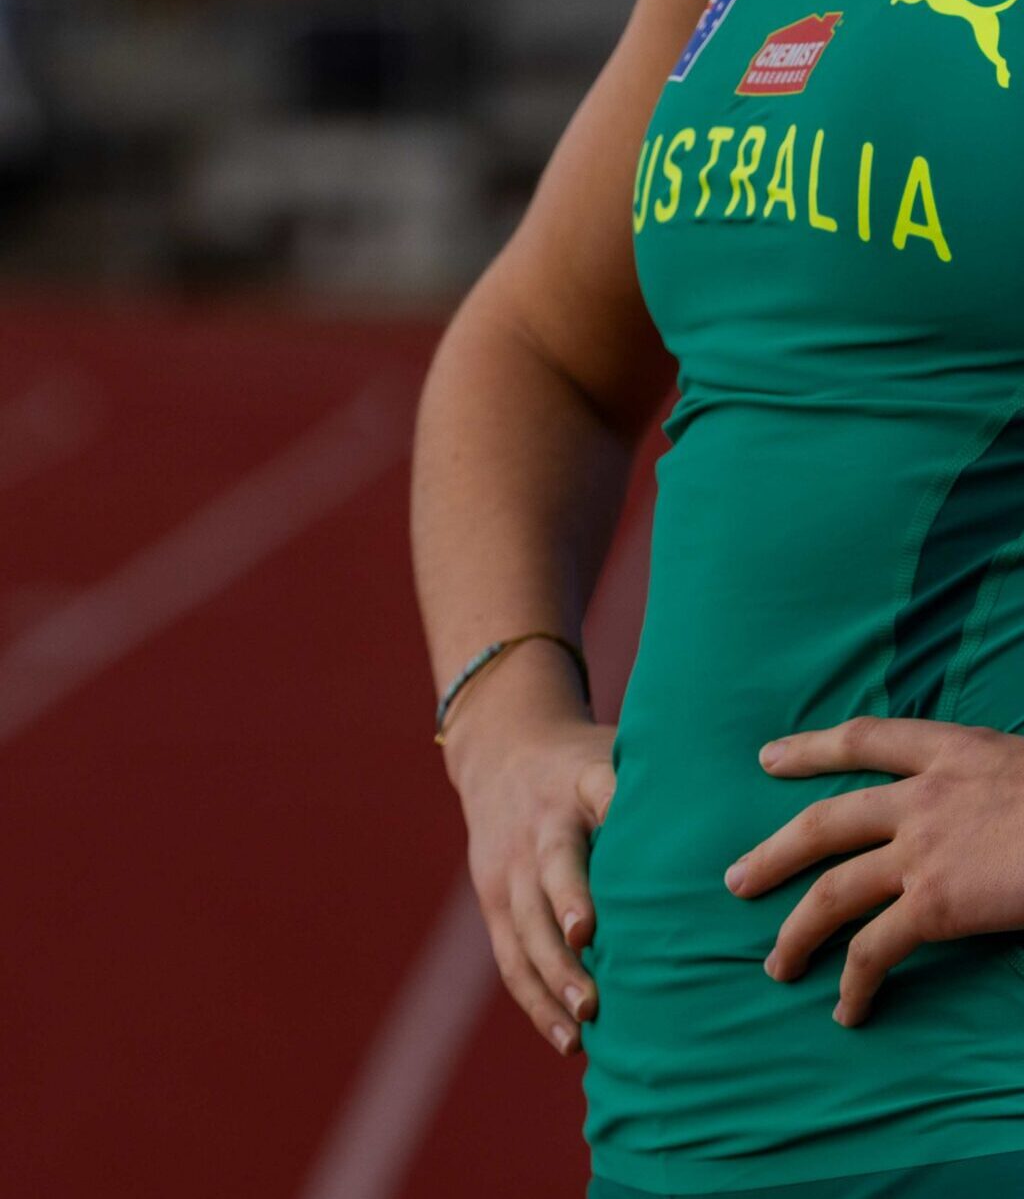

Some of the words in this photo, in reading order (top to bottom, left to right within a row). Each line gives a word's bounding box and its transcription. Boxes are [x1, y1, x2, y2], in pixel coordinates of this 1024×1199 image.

[756, 41, 824, 68] CHEMIST
[746, 69, 807, 85] WAREHOUSE
[633, 123, 953, 263] USTRALIA
